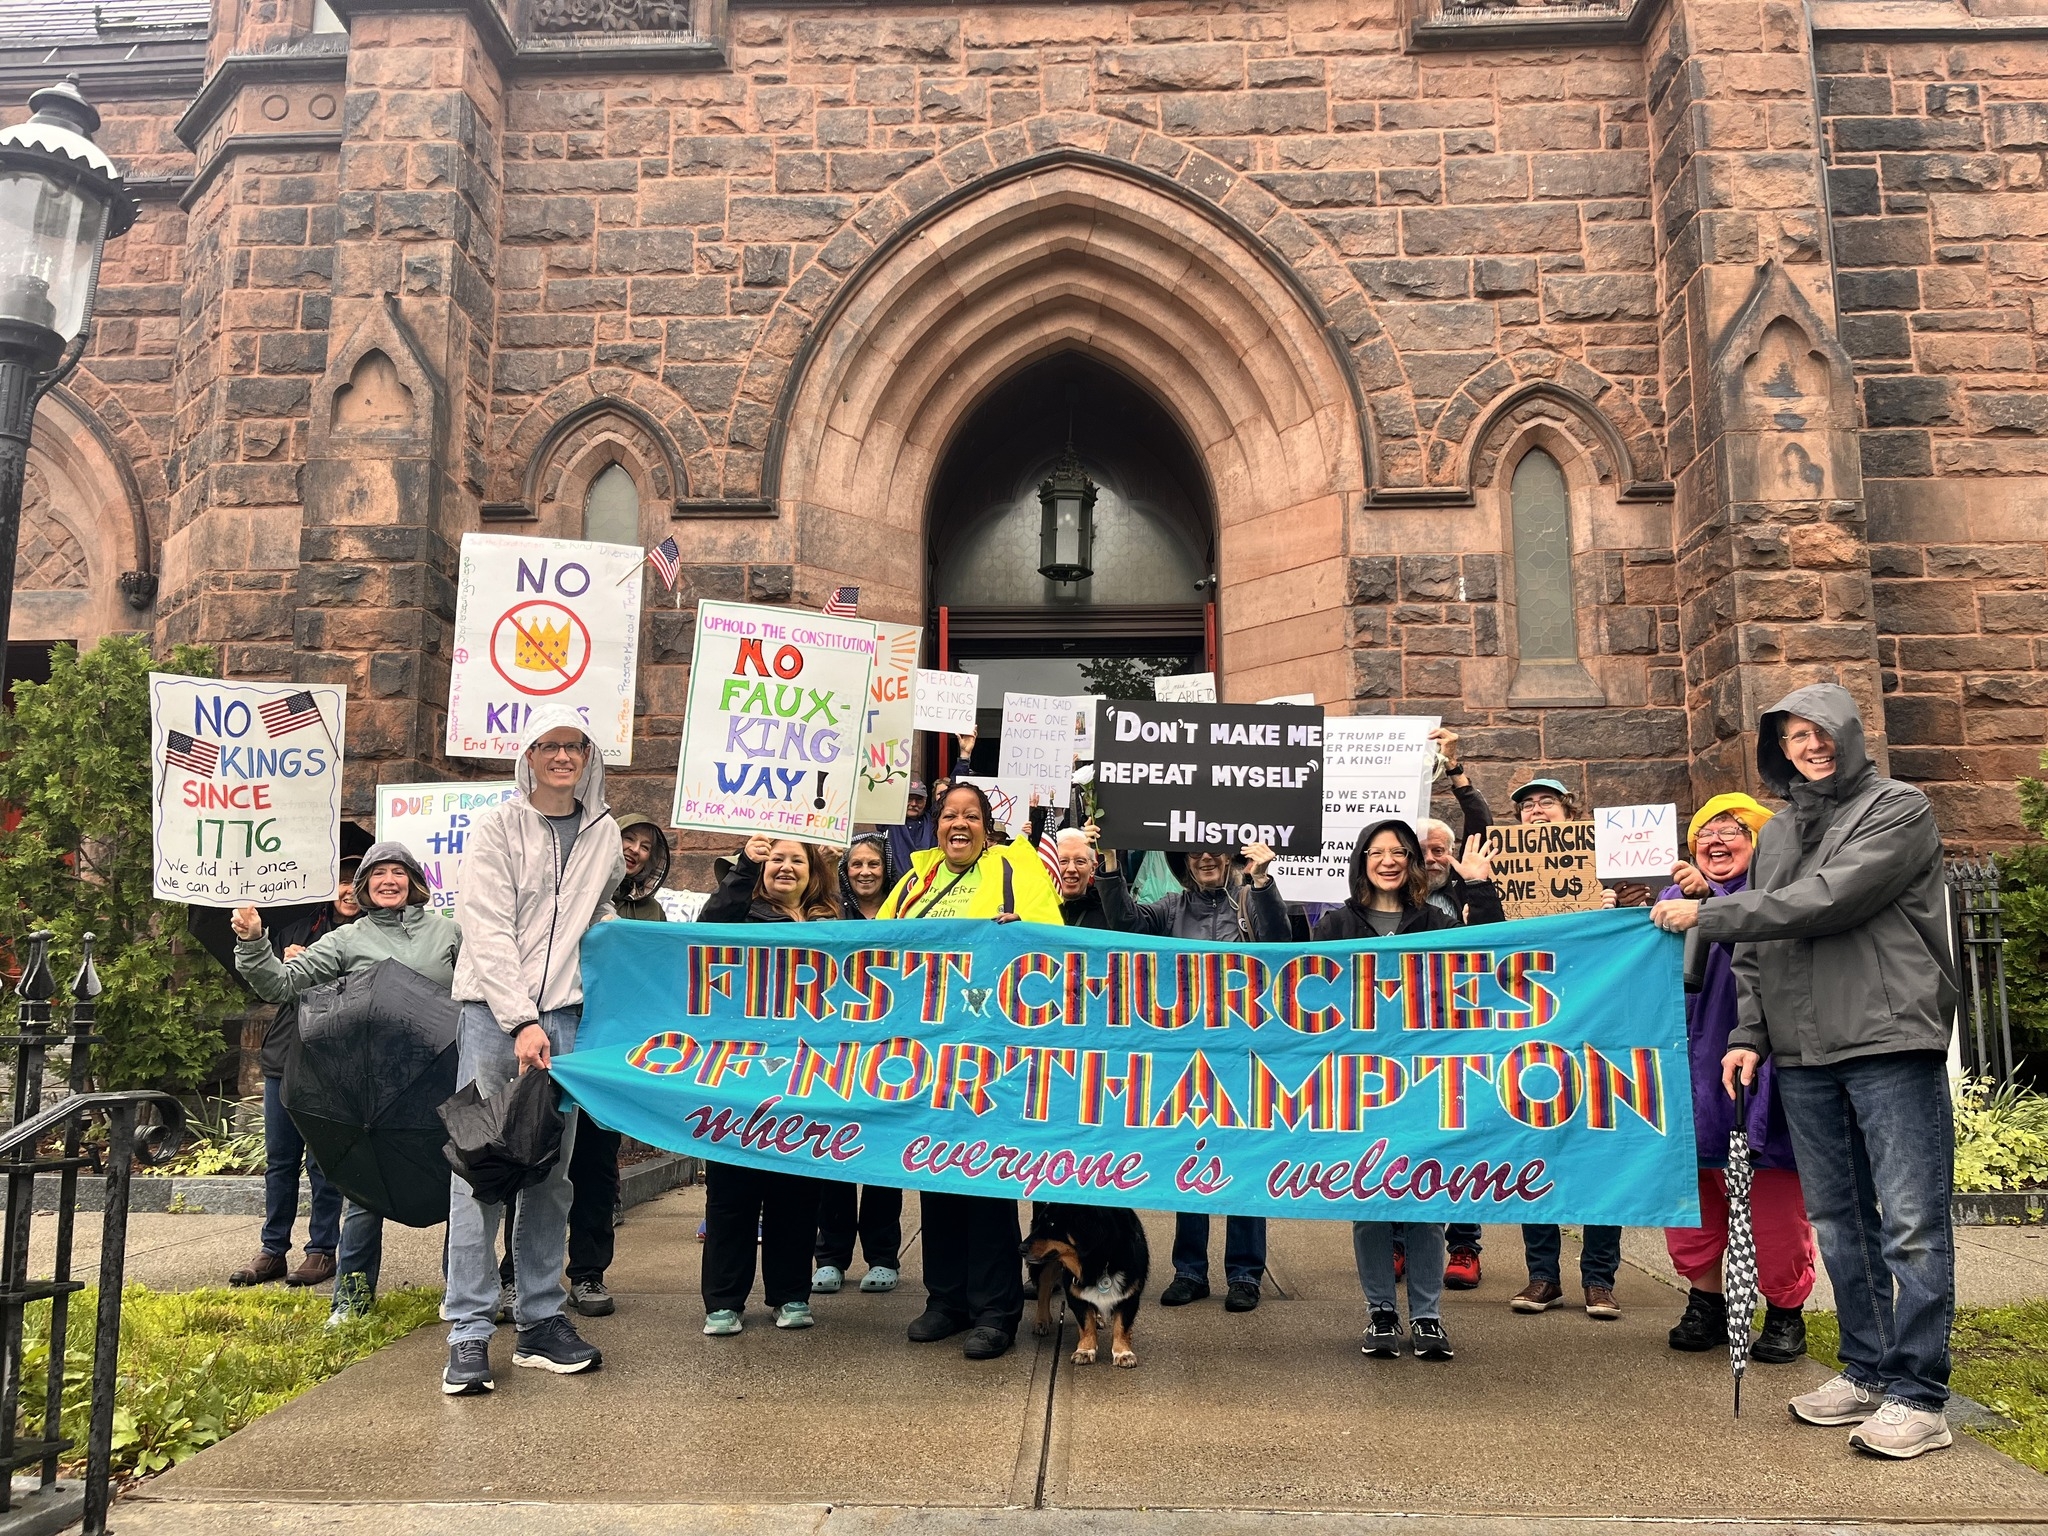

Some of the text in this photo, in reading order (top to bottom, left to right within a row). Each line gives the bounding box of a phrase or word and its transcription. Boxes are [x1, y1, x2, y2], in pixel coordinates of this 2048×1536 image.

[569, 542, 592, 551] Kind
[516, 557, 590, 597] NO
[622, 581, 636, 610] Truth
[704, 616, 756, 635] UPHOLD
[762, 623, 786, 640] THE
[791, 628, 875, 654] CONSTITUTION
[732, 637, 804, 680] NO
[452, 673, 462, 692] NIH
[719, 679, 851, 726] FAUX-
[937, 691, 974, 705] KINGS
[1006, 696, 1072, 711] WHEN I SAID
[194, 694, 251, 738] NO
[947, 708, 973, 722] 1776
[1007, 712, 1068, 726] LOVE ONE
[464, 737, 486, 751] End
[726, 715, 841, 764] KING
[1004, 728, 1067, 742] ANOTHER
[1210, 723, 1280, 746] MAKE
[1287, 725, 1322, 747] ME
[1339, 732, 1384, 740] TRUMP
[1388, 732, 1406, 740] BE
[601, 748, 622, 756] ess
[1012, 747, 1060, 762] DID I
[1347, 744, 1424, 752] PRESIDENT
[220, 745, 327, 779] KINGS
[1337, 756, 1345, 765] A
[1350, 756, 1391, 765] KING!!
[1006, 762, 1071, 779] MUMBLE?
[1100, 762, 1198, 785] REPEAT
[182, 780, 272, 810] SINCE
[1030, 783, 1057, 796] ESUS
[1338, 790, 1358, 799] WE
[1362, 790, 1406, 799] STAND
[392, 795, 433, 817] DUE
[1322, 803, 1401, 813] ED WE FALL
[450, 814, 470, 828] IS
[731, 806, 756, 819] AND
[760, 811, 775, 821] OF
[778, 811, 804, 825] THE
[806, 813, 849, 832] PEOPLE
[1606, 806, 1666, 829] KIN
[196, 817, 282, 859] 1776
[1489, 825, 1596, 854] OLIGARCHS
[1621, 830, 1654, 844] NOT
[1318, 855, 1330, 864] IN
[1490, 855, 1589, 876] WILL NOT
[1608, 847, 1675, 867] KINGS
[164, 858, 298, 877] We did it once
[1277, 866, 1345, 877] SILENT OR
[161, 876, 179, 889] We
[187, 880, 209, 893] can
[215, 881, 230, 895] do
[240, 882, 256, 895] it
[1551, 875, 1583, 900] U$
[687, 944, 1560, 1034] FIRST CHURCHES
[625, 1031, 1666, 1136] OF NORTHAMPTON
[685, 1095, 1555, 1203] where everyone is welcome
